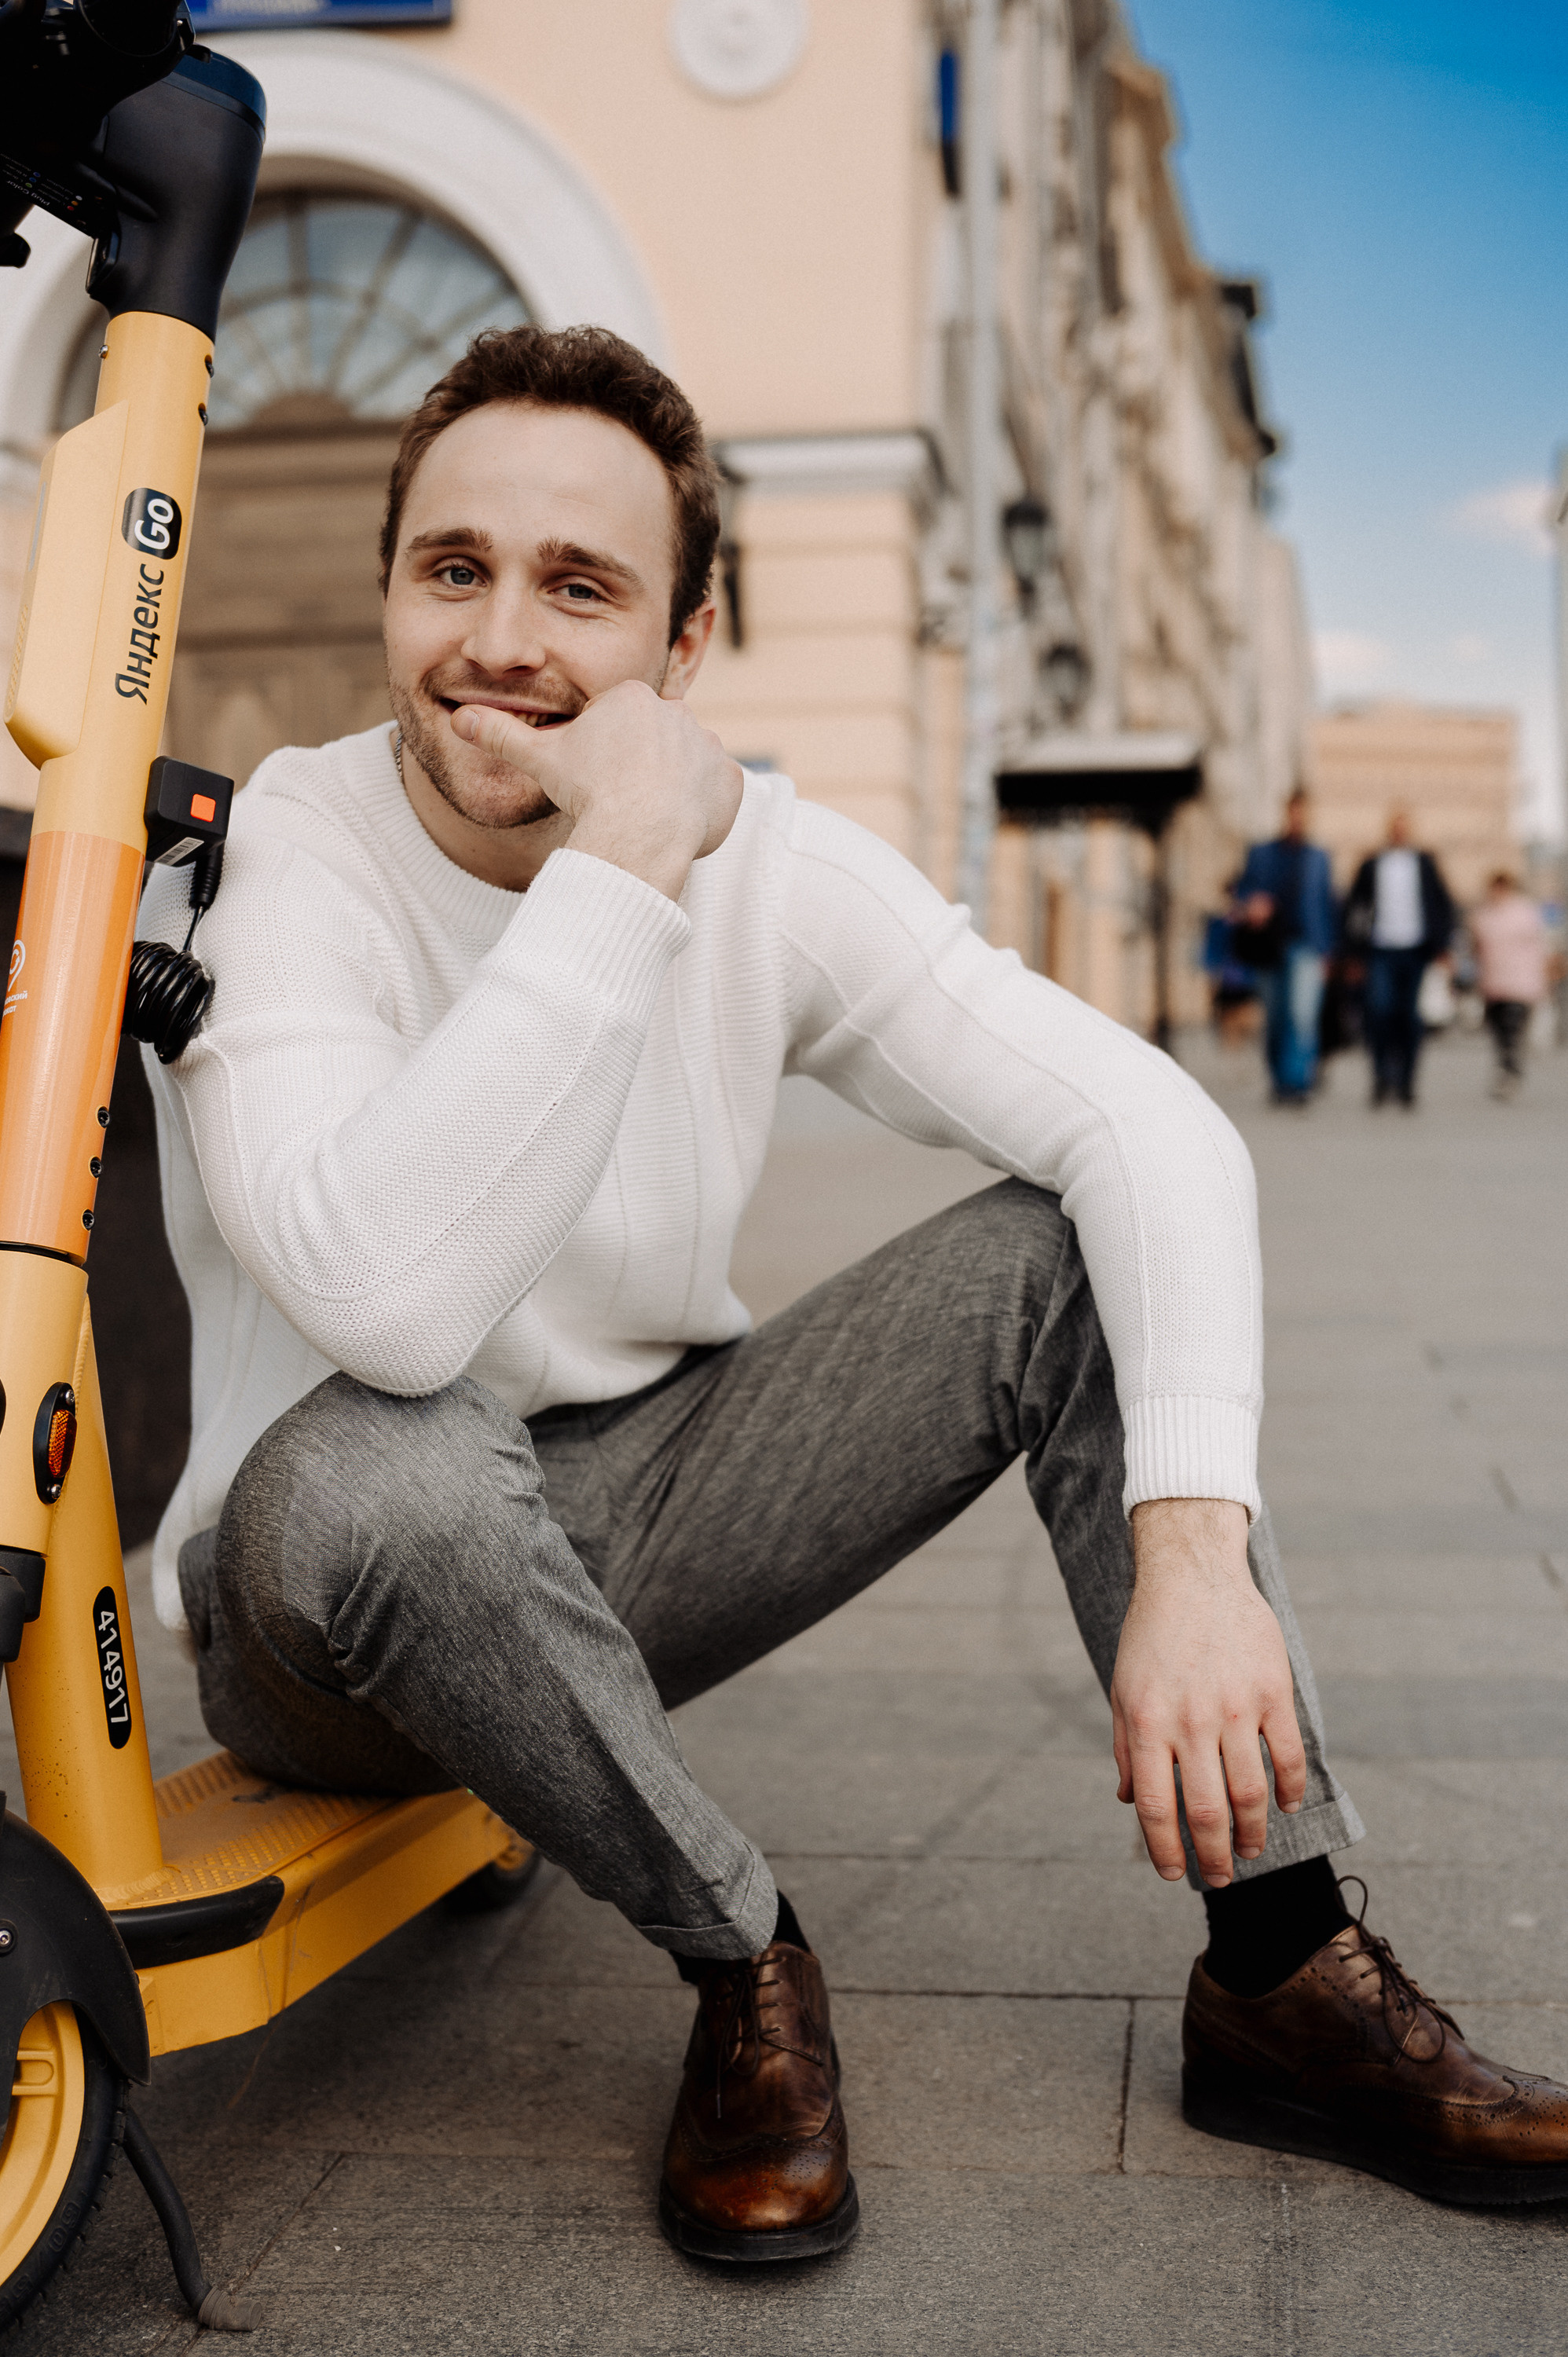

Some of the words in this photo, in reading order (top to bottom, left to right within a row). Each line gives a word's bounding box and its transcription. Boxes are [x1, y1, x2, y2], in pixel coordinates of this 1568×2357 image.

[6, 180, 30, 195] Color
[31, 192, 51, 206] Plug
[134, 498, 174, 551] Go
[115, 563, 164, 706] Яндекс
[98, 1611, 129, 1724] 414917
